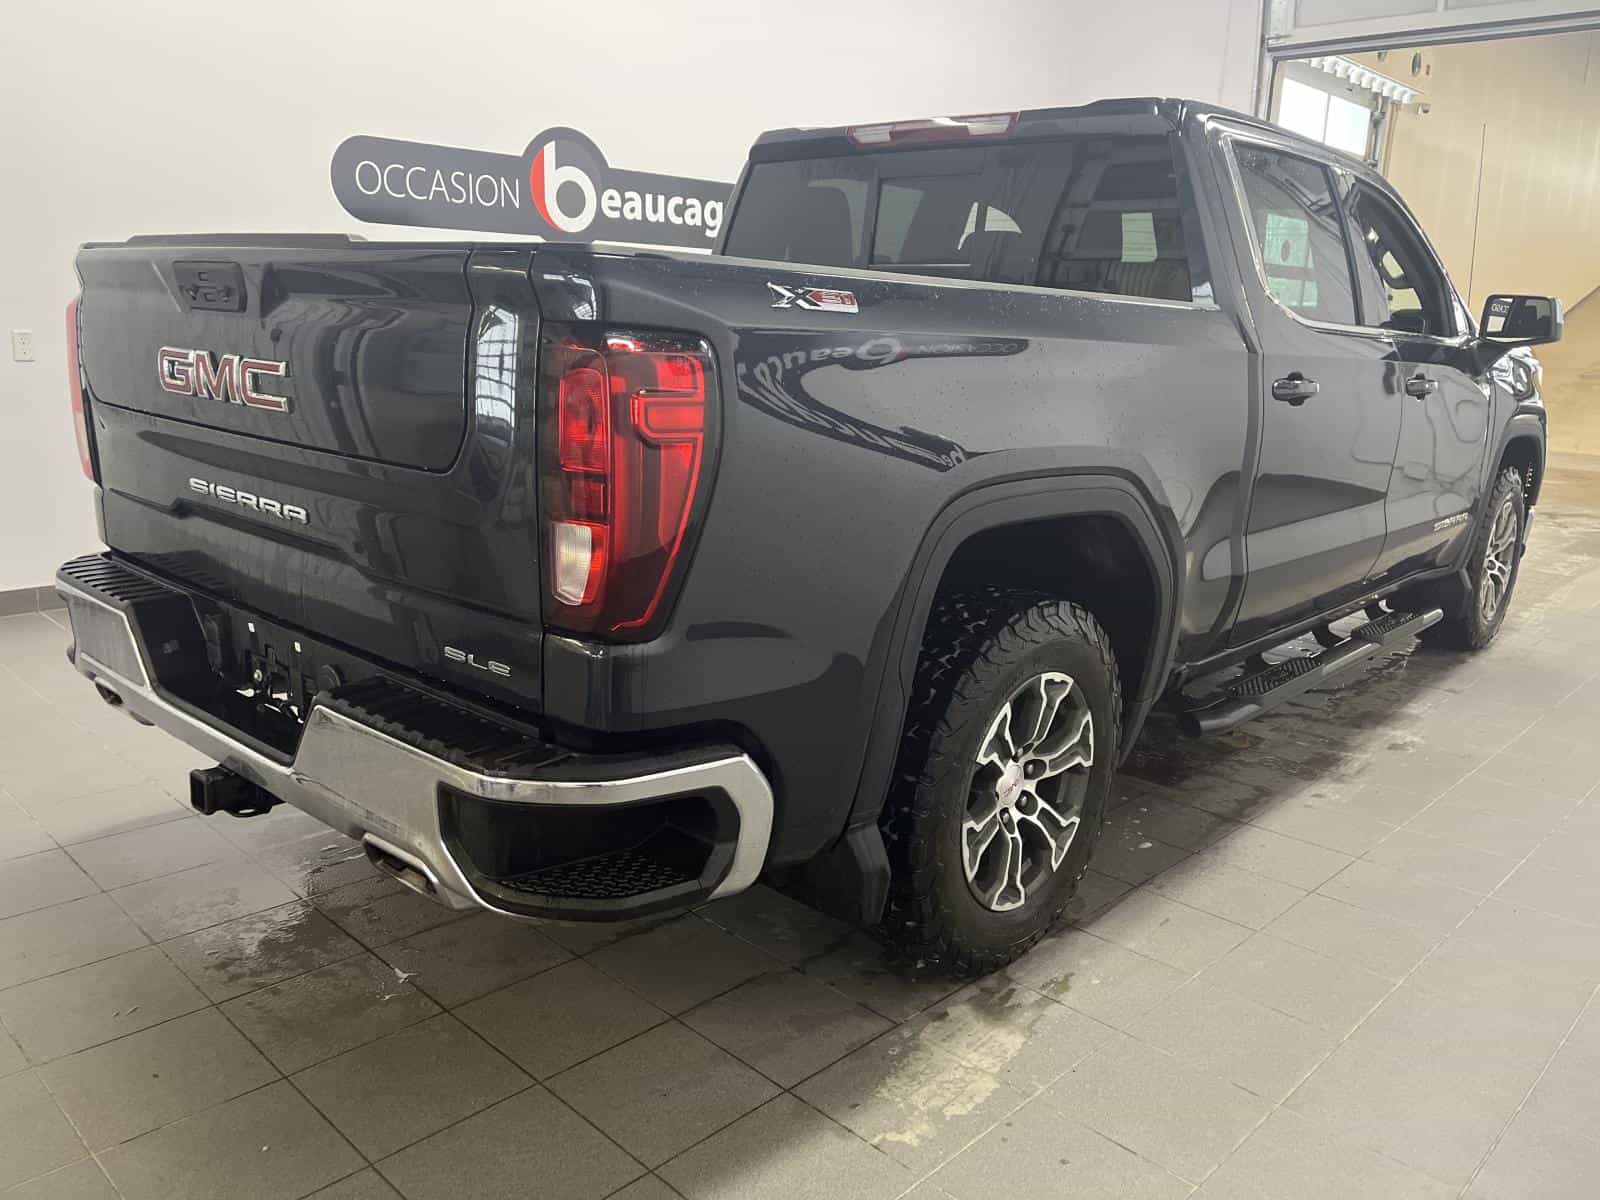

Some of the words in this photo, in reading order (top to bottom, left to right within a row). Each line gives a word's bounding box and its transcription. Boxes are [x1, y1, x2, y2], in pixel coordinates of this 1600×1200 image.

[355, 160, 520, 209] OCCASION
[157, 345, 289, 413] GMC
[188, 477, 310, 526] SIERRA
[443, 645, 512, 678] SLE
